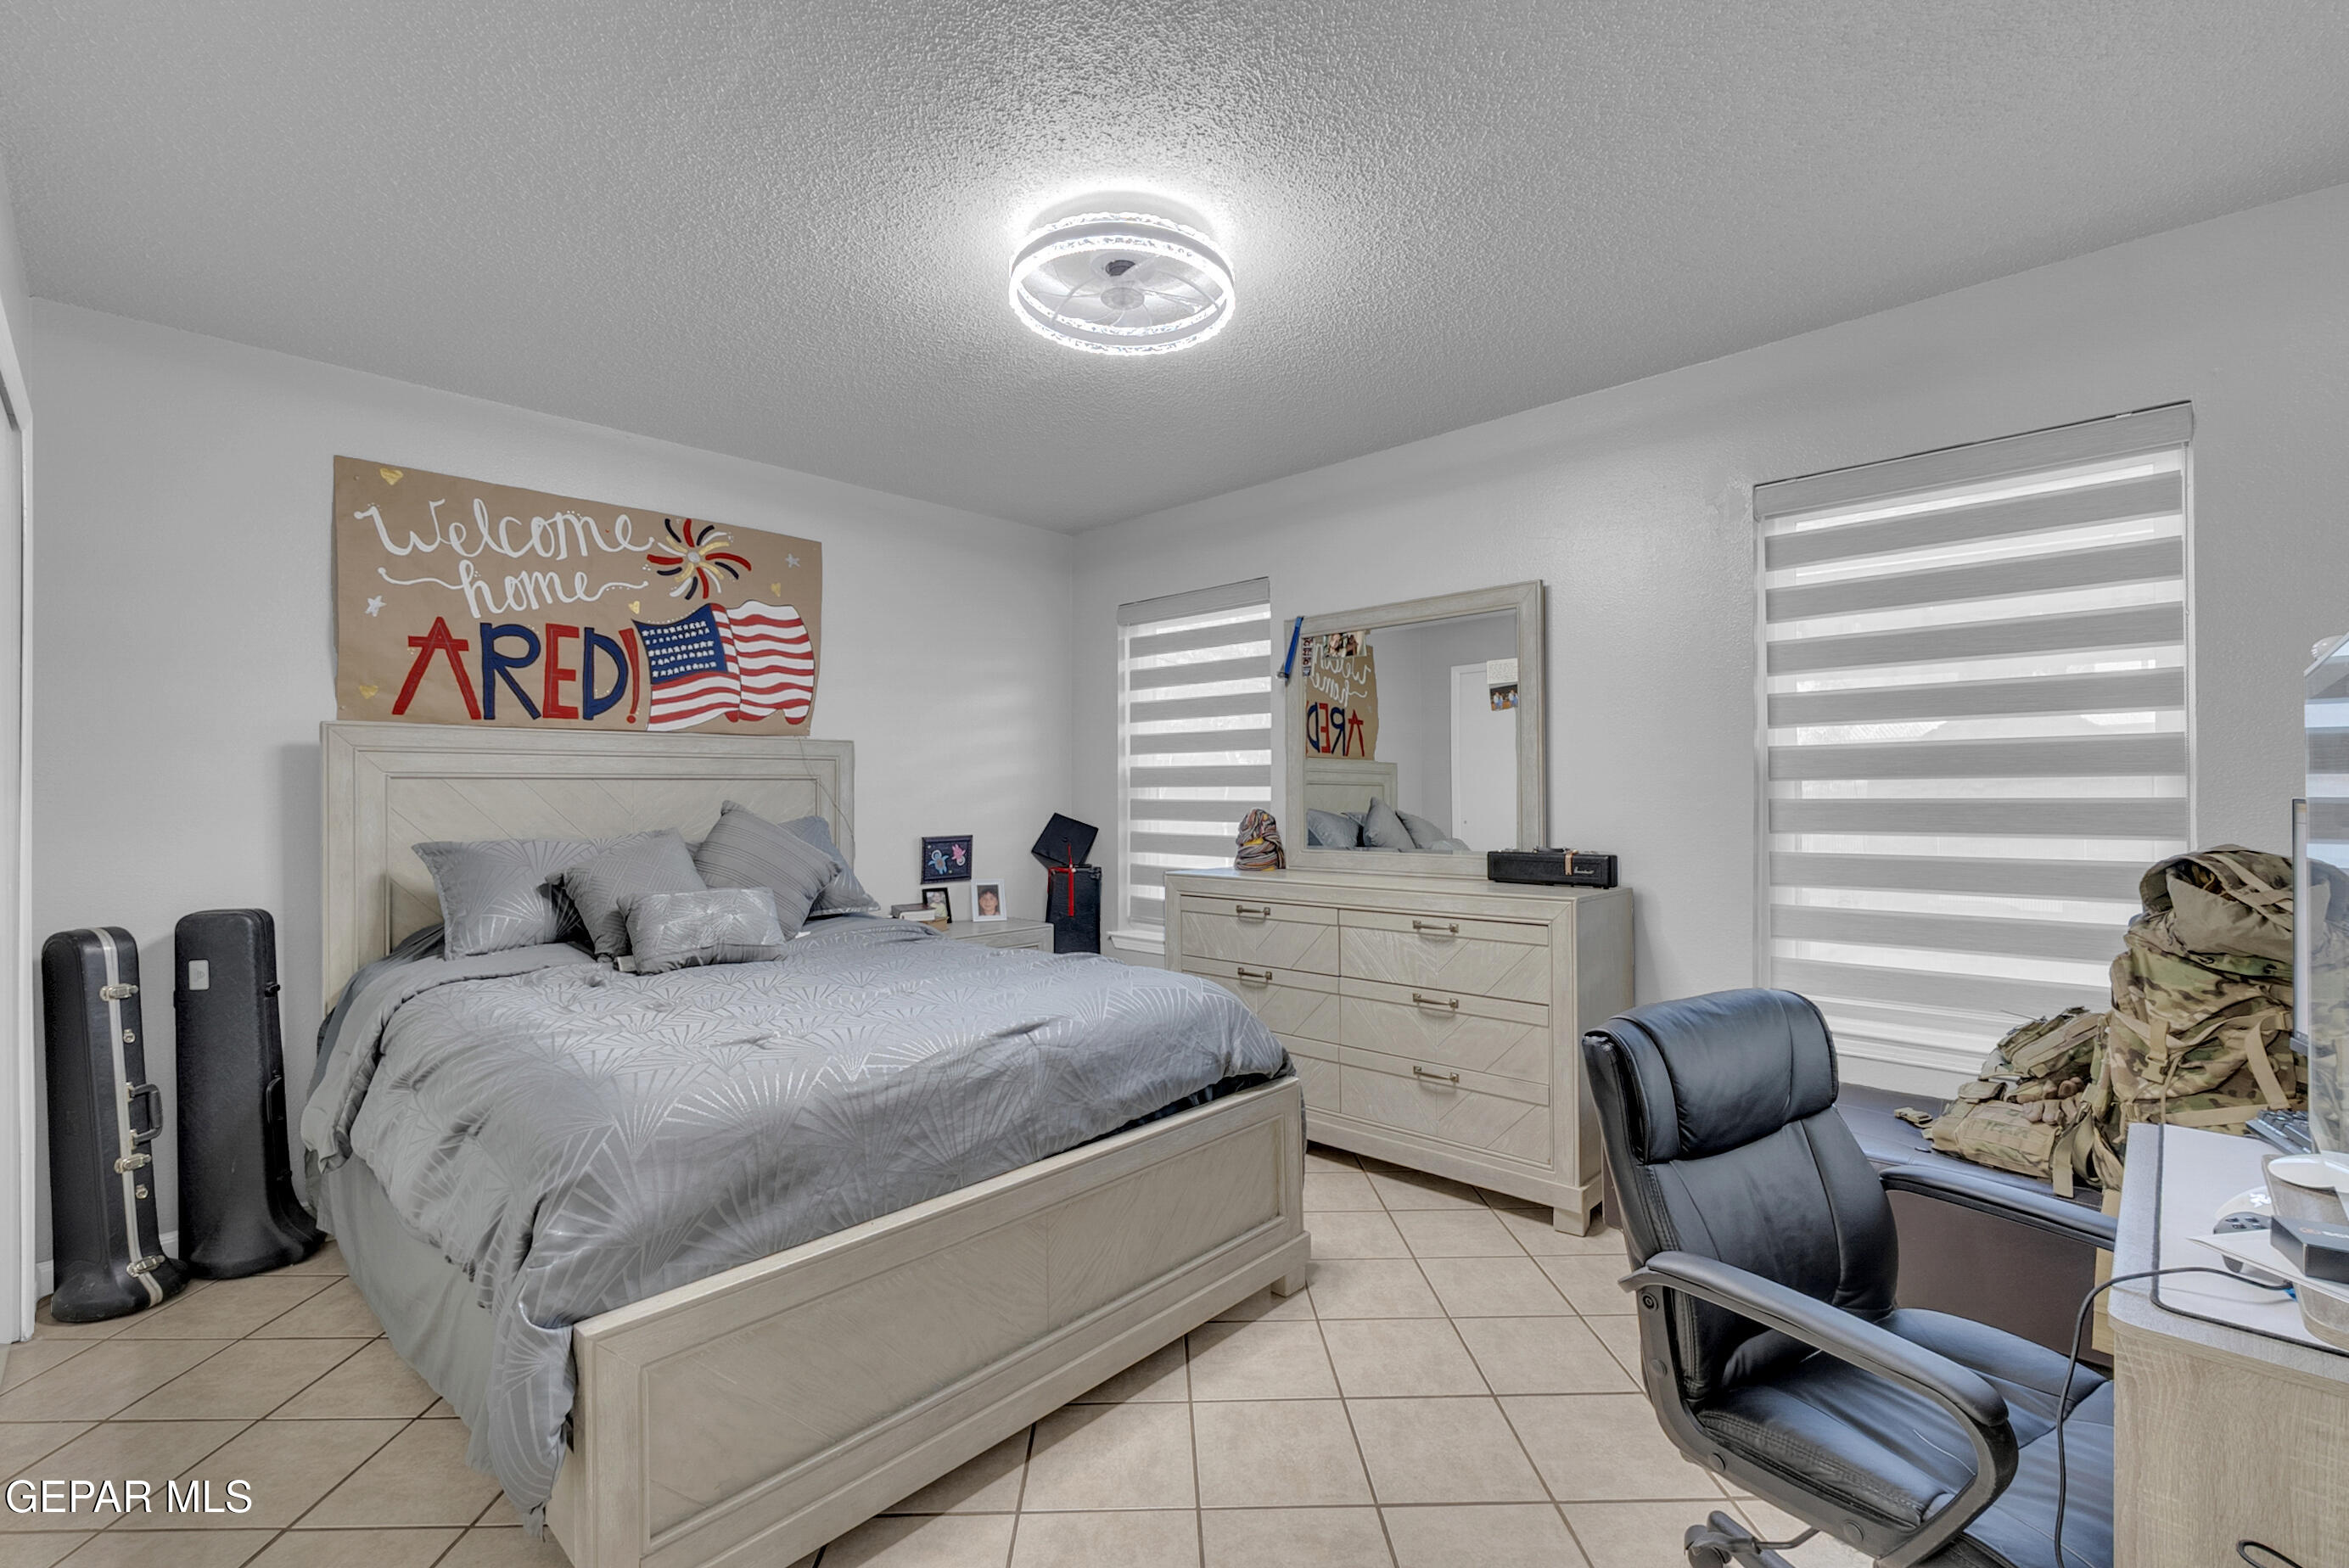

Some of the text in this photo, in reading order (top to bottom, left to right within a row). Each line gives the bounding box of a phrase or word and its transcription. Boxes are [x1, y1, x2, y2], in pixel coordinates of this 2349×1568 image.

[354, 498, 655, 561] Welcome
[378, 559, 649, 619] home
[391, 616, 642, 724] ARED!
